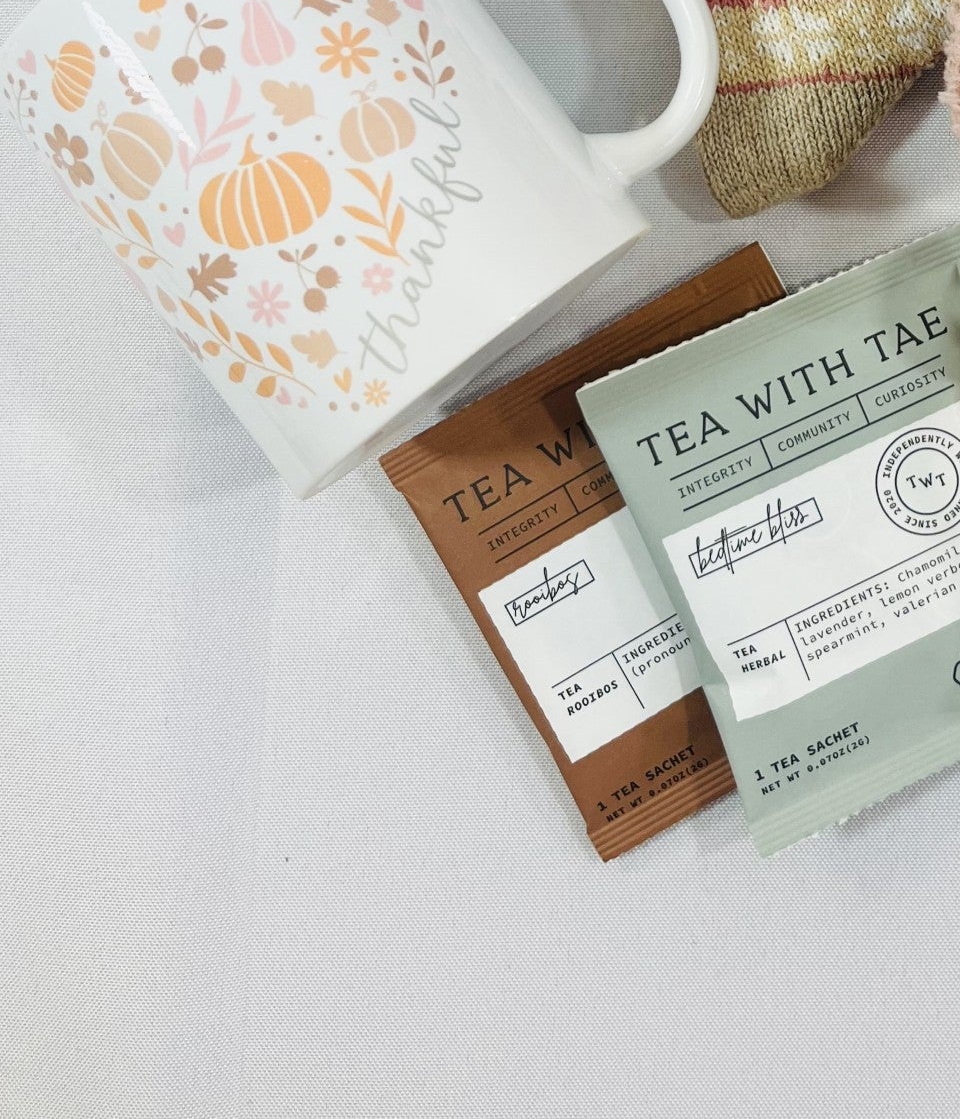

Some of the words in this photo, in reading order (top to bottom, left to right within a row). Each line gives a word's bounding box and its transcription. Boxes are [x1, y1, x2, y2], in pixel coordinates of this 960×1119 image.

[358, 97, 483, 374] thankful
[636, 410, 730, 466] TEA
[735, 348, 855, 419] WITH
[863, 306, 948, 362] TAE
[875, 366, 946, 407] CURIOSITY
[777, 410, 851, 452] COMMUNITY
[442, 463, 533, 523] TEA
[536, 421, 597, 466] WI
[677, 455, 754, 499] INTEGRITY
[883, 434, 954, 478] INDEPENDENTLY
[582, 471, 616, 495] COMM
[906, 472, 946, 489] TWT
[883, 489, 902, 516] 2020
[904, 515, 938, 528] SINCE
[487, 503, 559, 551] INTEGRITY
[696, 525, 763, 574] bedtime
[766, 498, 809, 545] bliss
[512, 567, 579, 619] rooibos
[794, 581, 889, 633] INGREDIENTS:
[800, 609, 872, 646] lavender,
[880, 584, 920, 608] lemon
[807, 620, 885, 661] spearmint,
[893, 583, 957, 618] valerian
[622, 622, 685, 664] INGREDIE
[632, 637, 691, 677] (pronoun
[733, 644, 757, 659] TEA
[741, 650, 787, 673] HERBAL
[557, 683, 582, 701] TEA
[567, 680, 618, 716] ROOIBOS
[754, 769, 765, 781] 1
[770, 753, 800, 773] TEA
[807, 722, 859, 755] SACHET
[597, 801, 607, 812] 1
[611, 781, 640, 801] TEA
[645, 745, 695, 781] SACHET
[761, 781, 781, 795] NET
[786, 771, 800, 782] WT
[606, 807, 626, 822] NET
[630, 796, 643, 808] WT
